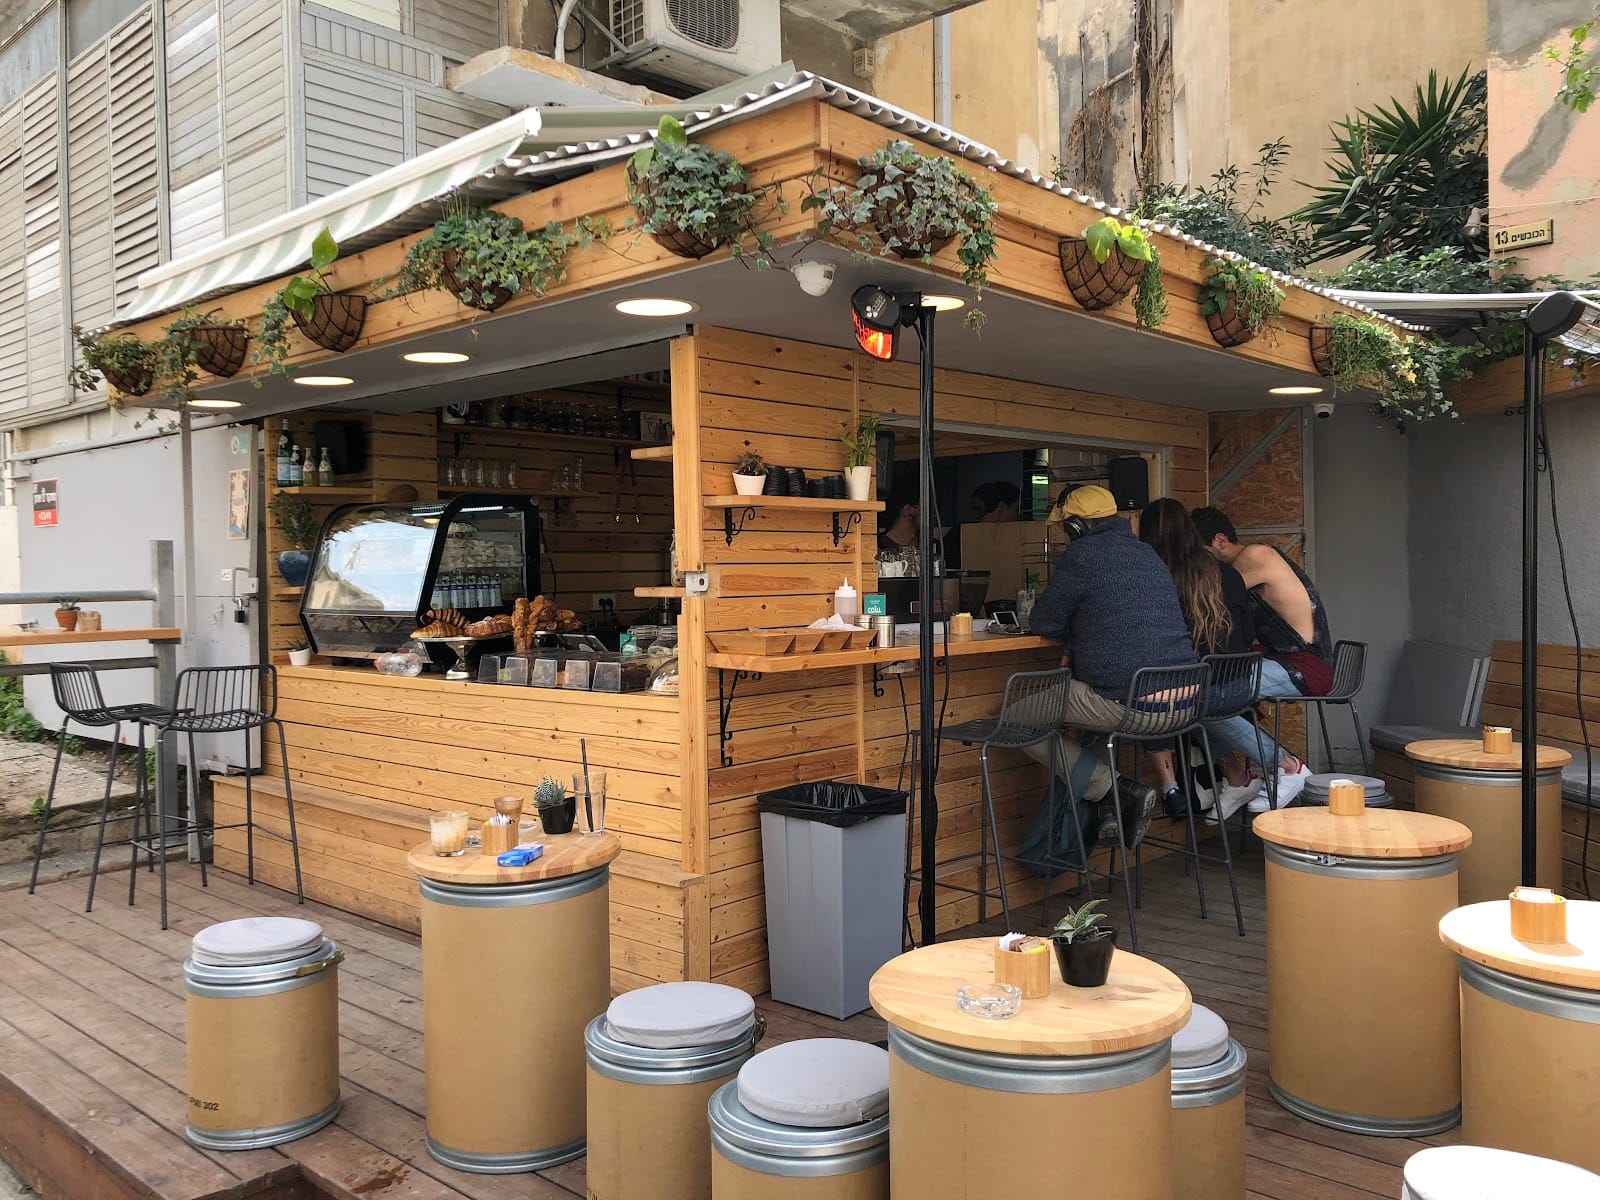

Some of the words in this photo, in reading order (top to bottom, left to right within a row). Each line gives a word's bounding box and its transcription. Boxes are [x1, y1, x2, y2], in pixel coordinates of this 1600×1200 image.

[1495, 230, 1509, 245] 13
[1511, 229, 1545, 242] הכובשים
[202, 1101, 220, 1111] 302
